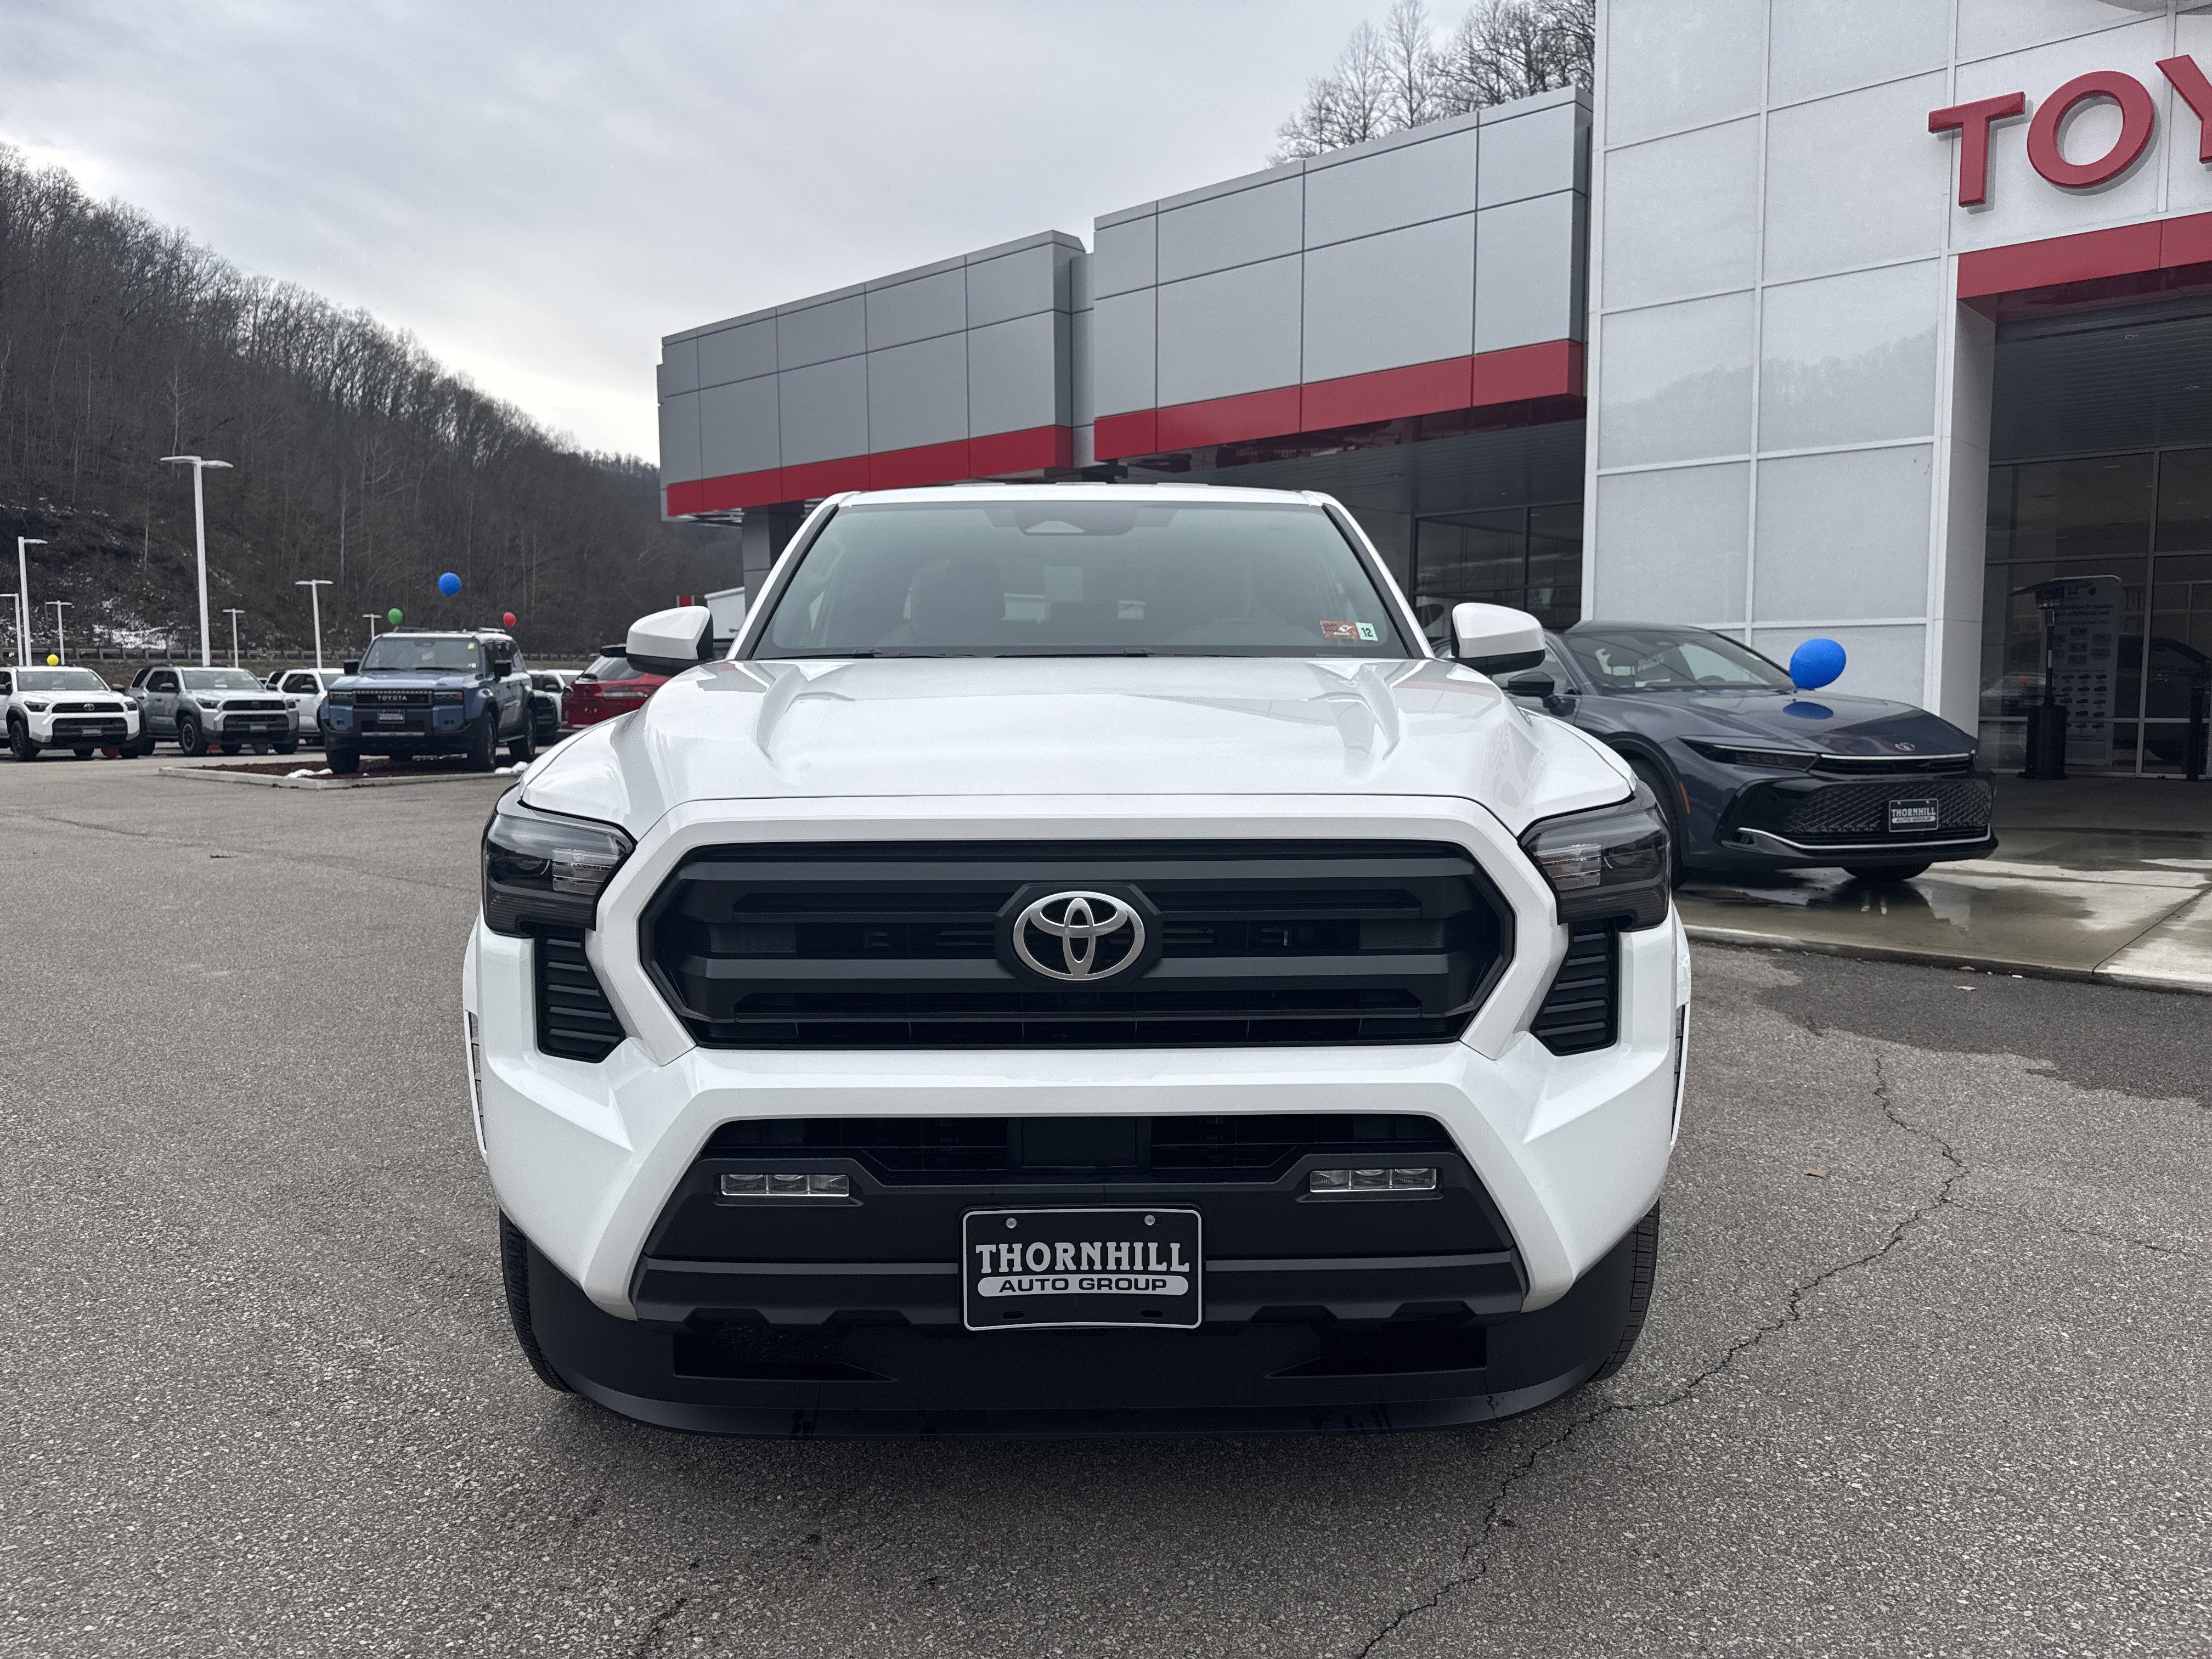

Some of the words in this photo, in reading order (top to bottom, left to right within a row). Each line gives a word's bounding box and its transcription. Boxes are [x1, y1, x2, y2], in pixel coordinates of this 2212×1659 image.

[1361, 627, 1373, 637] 12
[1891, 807, 1936, 816] THORNHILL
[975, 1242, 1189, 1273] THORNHILL
[998, 1278, 1069, 1293] AUTO
[1079, 1278, 1167, 1291] GROUP
